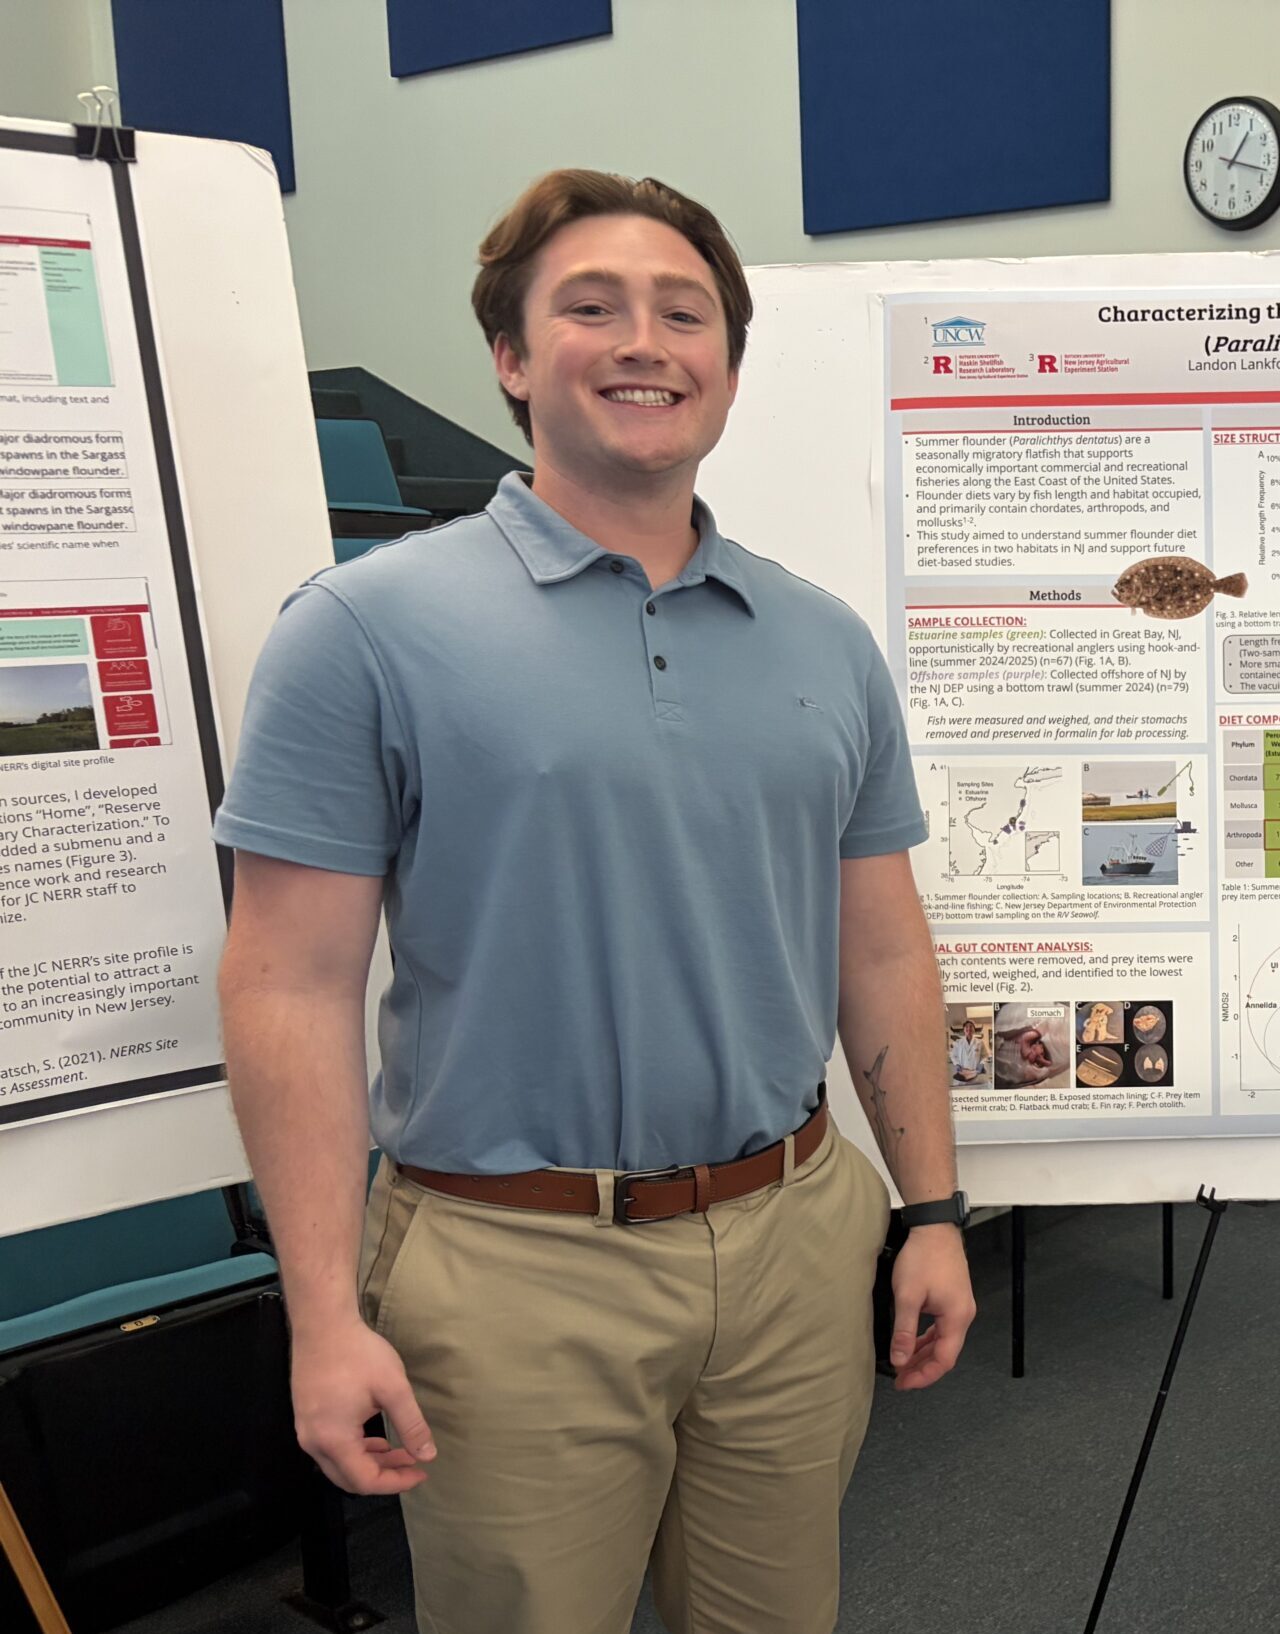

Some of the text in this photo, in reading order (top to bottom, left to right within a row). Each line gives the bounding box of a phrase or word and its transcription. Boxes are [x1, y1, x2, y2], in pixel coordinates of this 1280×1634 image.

[1228, 113, 1240, 128] 12
[1249, 118, 1254, 132] 1
[1212, 121, 1223, 136] 11
[1201, 139, 1214, 153] 10
[1259, 133, 1267, 147] 2
[1195, 160, 1202, 173] 9
[1199, 178, 1208, 191] 8
[1228, 196, 1235, 210] 6
[1098, 304, 1260, 324] Characterizing
[932, 327, 983, 342] UNCW
[933, 356, 953, 374] R
[1038, 354, 1058, 373] R
[1188, 354, 1237, 371] Landon
[1013, 414, 1091, 426] Introduction
[915, 434, 1150, 447] Summer flounder (Paralichthys dentatus) are a
[1213, 433, 1236, 443] SIZE
[916, 528, 1197, 542] This study aimed to understand summer flounder diet
[1029, 589, 1082, 601] Methods
[908, 616, 1026, 626] SAMPLE COLLECTION:
[927, 714, 1187, 727] Fish were measured and weighed, and their stomachs
[1219, 715, 1243, 724] DIET
[1231, 740, 1255, 749] Phylum
[1229, 774, 1258, 782] Chordata
[10, 783, 157, 806] sources, I developed
[1230, 802, 1258, 810] Mollusca
[21, 814, 170, 838] Characterization.” To
[1226, 831, 1262, 840] Arthropoda
[1235, 860, 1254, 868] Other
[0, 882, 136, 907] for JC NERR staff to
[954, 942, 1093, 952] GUT CONTENT ANALYSIS:
[7, 943, 193, 978] the JC NERR’s site profile is
[77, 995, 175, 1016] in New Jersey.
[1029, 1008, 1062, 1018] Stomach
[42, 1039, 178, 1071] S. (2021). NERRS Site
